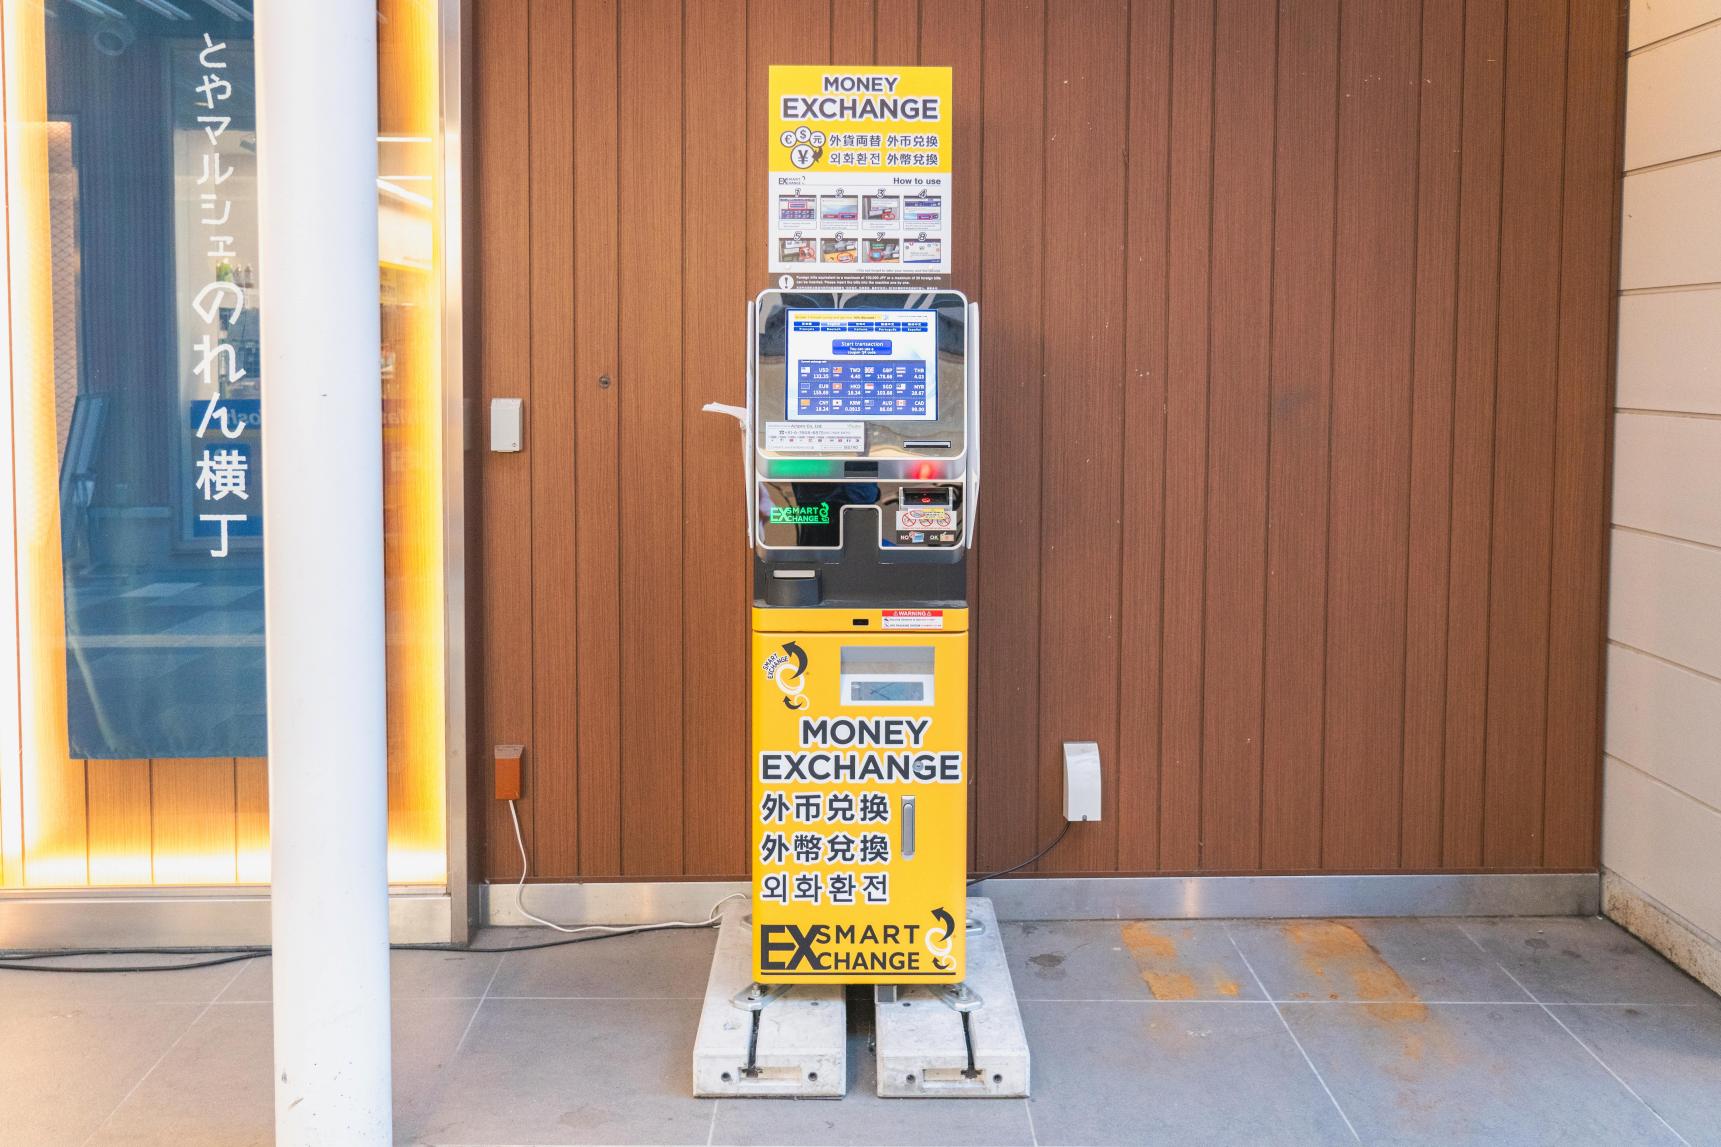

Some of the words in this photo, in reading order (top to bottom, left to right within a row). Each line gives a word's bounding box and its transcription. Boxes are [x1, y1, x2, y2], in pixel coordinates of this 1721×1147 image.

[824, 76, 898, 92] MONEY
[783, 98, 938, 120] EXCHANGE
[830, 134, 881, 147] 外貨両替
[830, 152, 880, 165] 외화환전
[192, 32, 249, 558] とやマルシェのれん横丁
[770, 507, 787, 522] EX
[763, 653, 778, 670] SMART
[768, 656, 788, 679] EXCHANGE
[803, 719, 929, 745] MONEY
[763, 754, 960, 781] EXCHANGE
[761, 793, 889, 822] 外币兑换
[761, 833, 889, 862] 外幣兌換
[762, 874, 888, 903] 외화환전
[761, 924, 820, 971] EX
[816, 924, 920, 944] SMART
[816, 951, 920, 971] CHANGE
